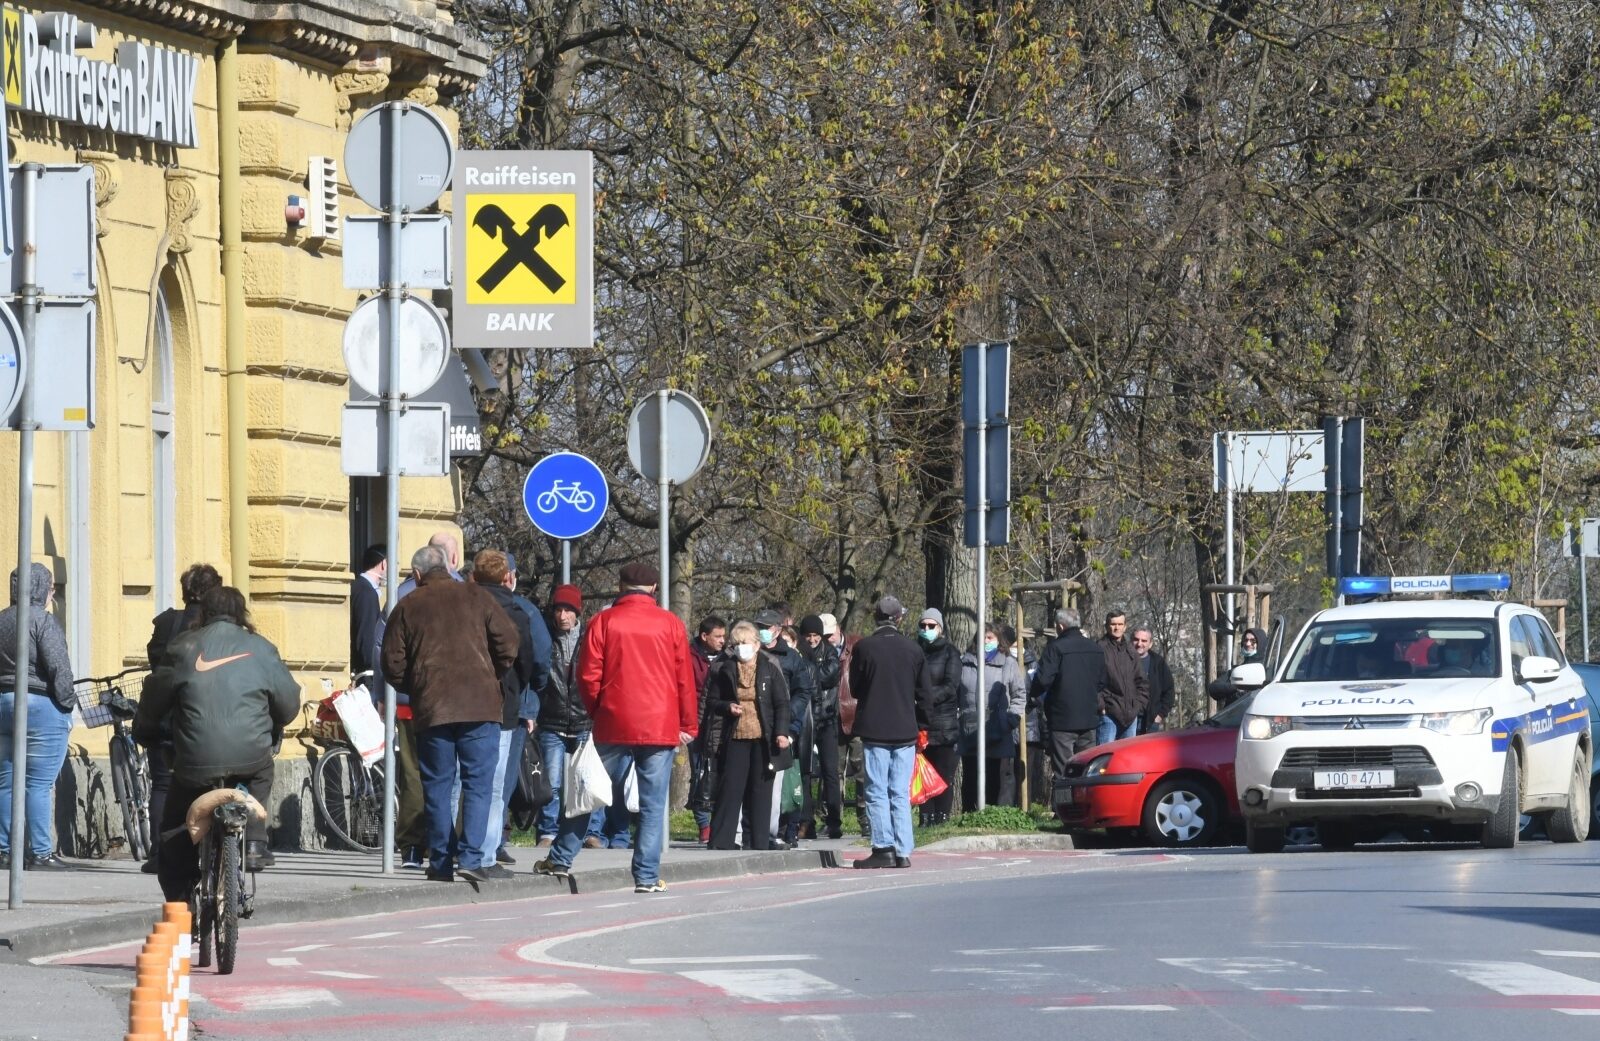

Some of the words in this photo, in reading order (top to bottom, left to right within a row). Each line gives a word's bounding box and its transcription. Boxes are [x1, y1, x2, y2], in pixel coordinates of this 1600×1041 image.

[465, 165, 576, 185] Raiffeisen
[486, 312, 555, 331] BANK
[1393, 580, 1449, 589] POLICIJA
[1301, 697, 1415, 708] POLICIJA
[1531, 717, 1554, 735] POLICIJA
[1327, 772, 1349, 786] 100
[1360, 771, 1382, 785] 471
